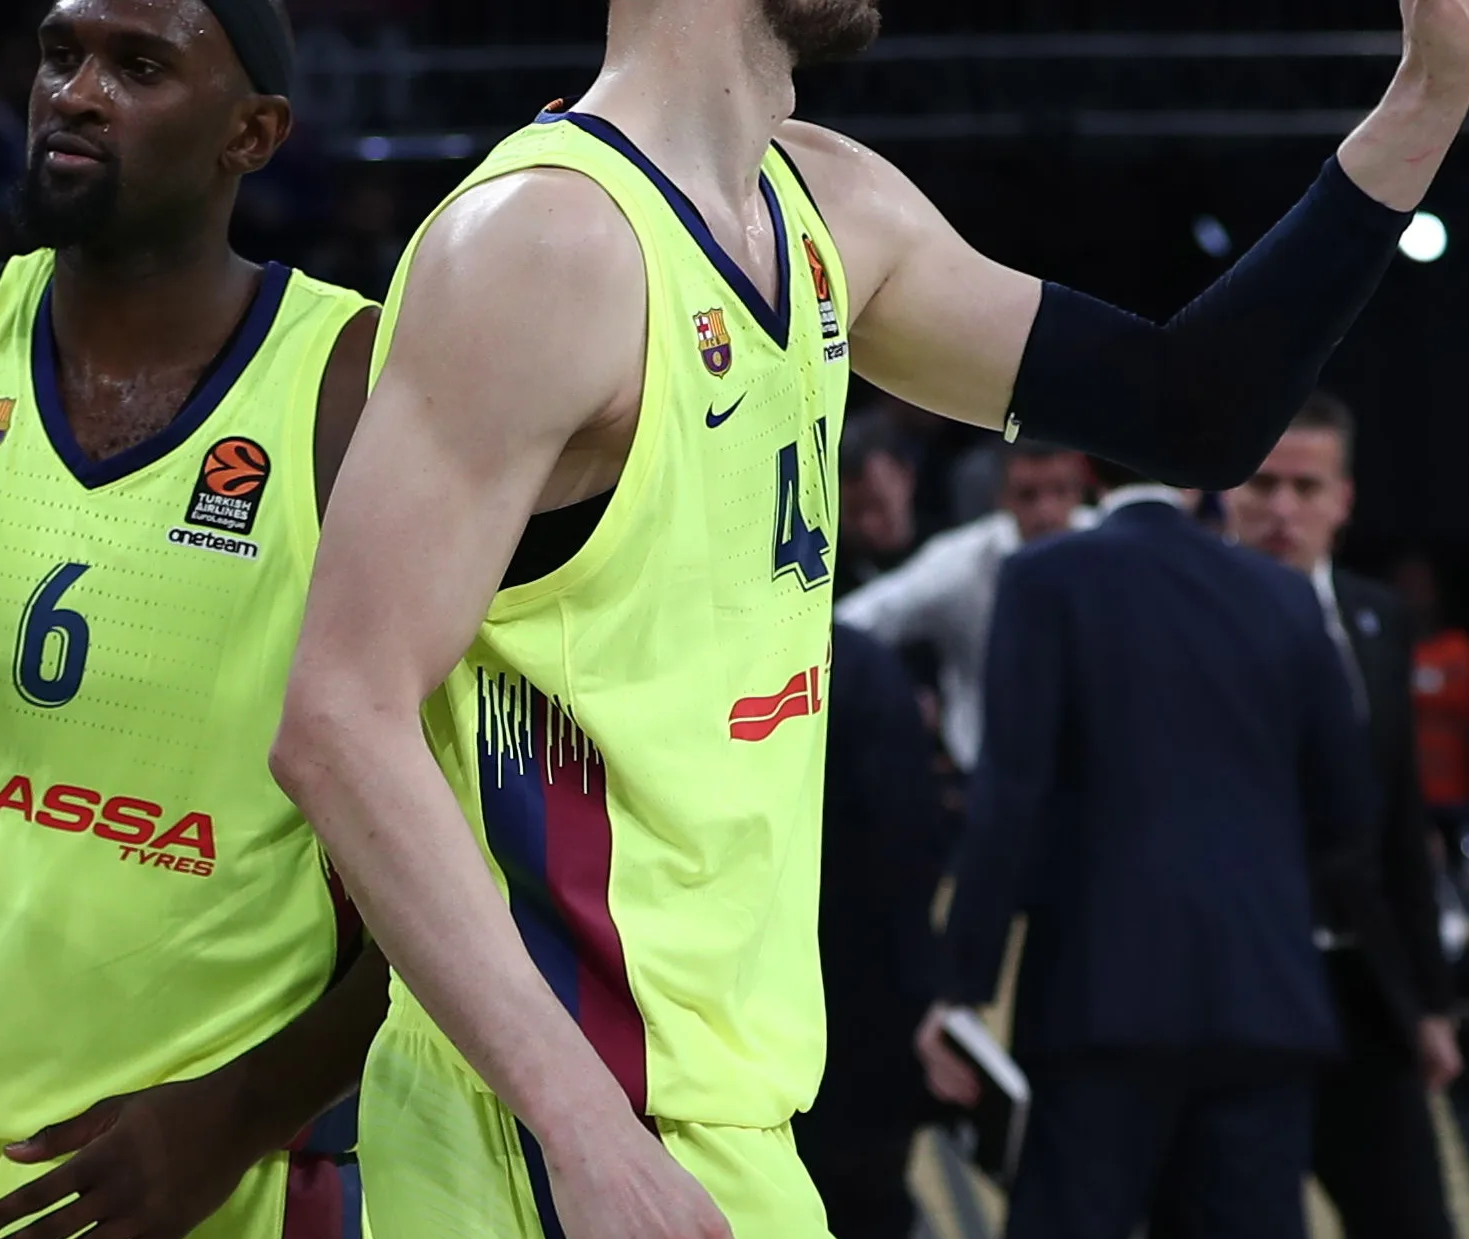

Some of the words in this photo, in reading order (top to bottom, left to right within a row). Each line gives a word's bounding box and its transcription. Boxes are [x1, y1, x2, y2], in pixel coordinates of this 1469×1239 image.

[194, 502, 249, 521] AIRLINES
[198, 492, 252, 511] TURKISH
[168, 528, 259, 558] oneteam
[12, 562, 92, 709] 6
[118, 844, 215, 878] TYRES
